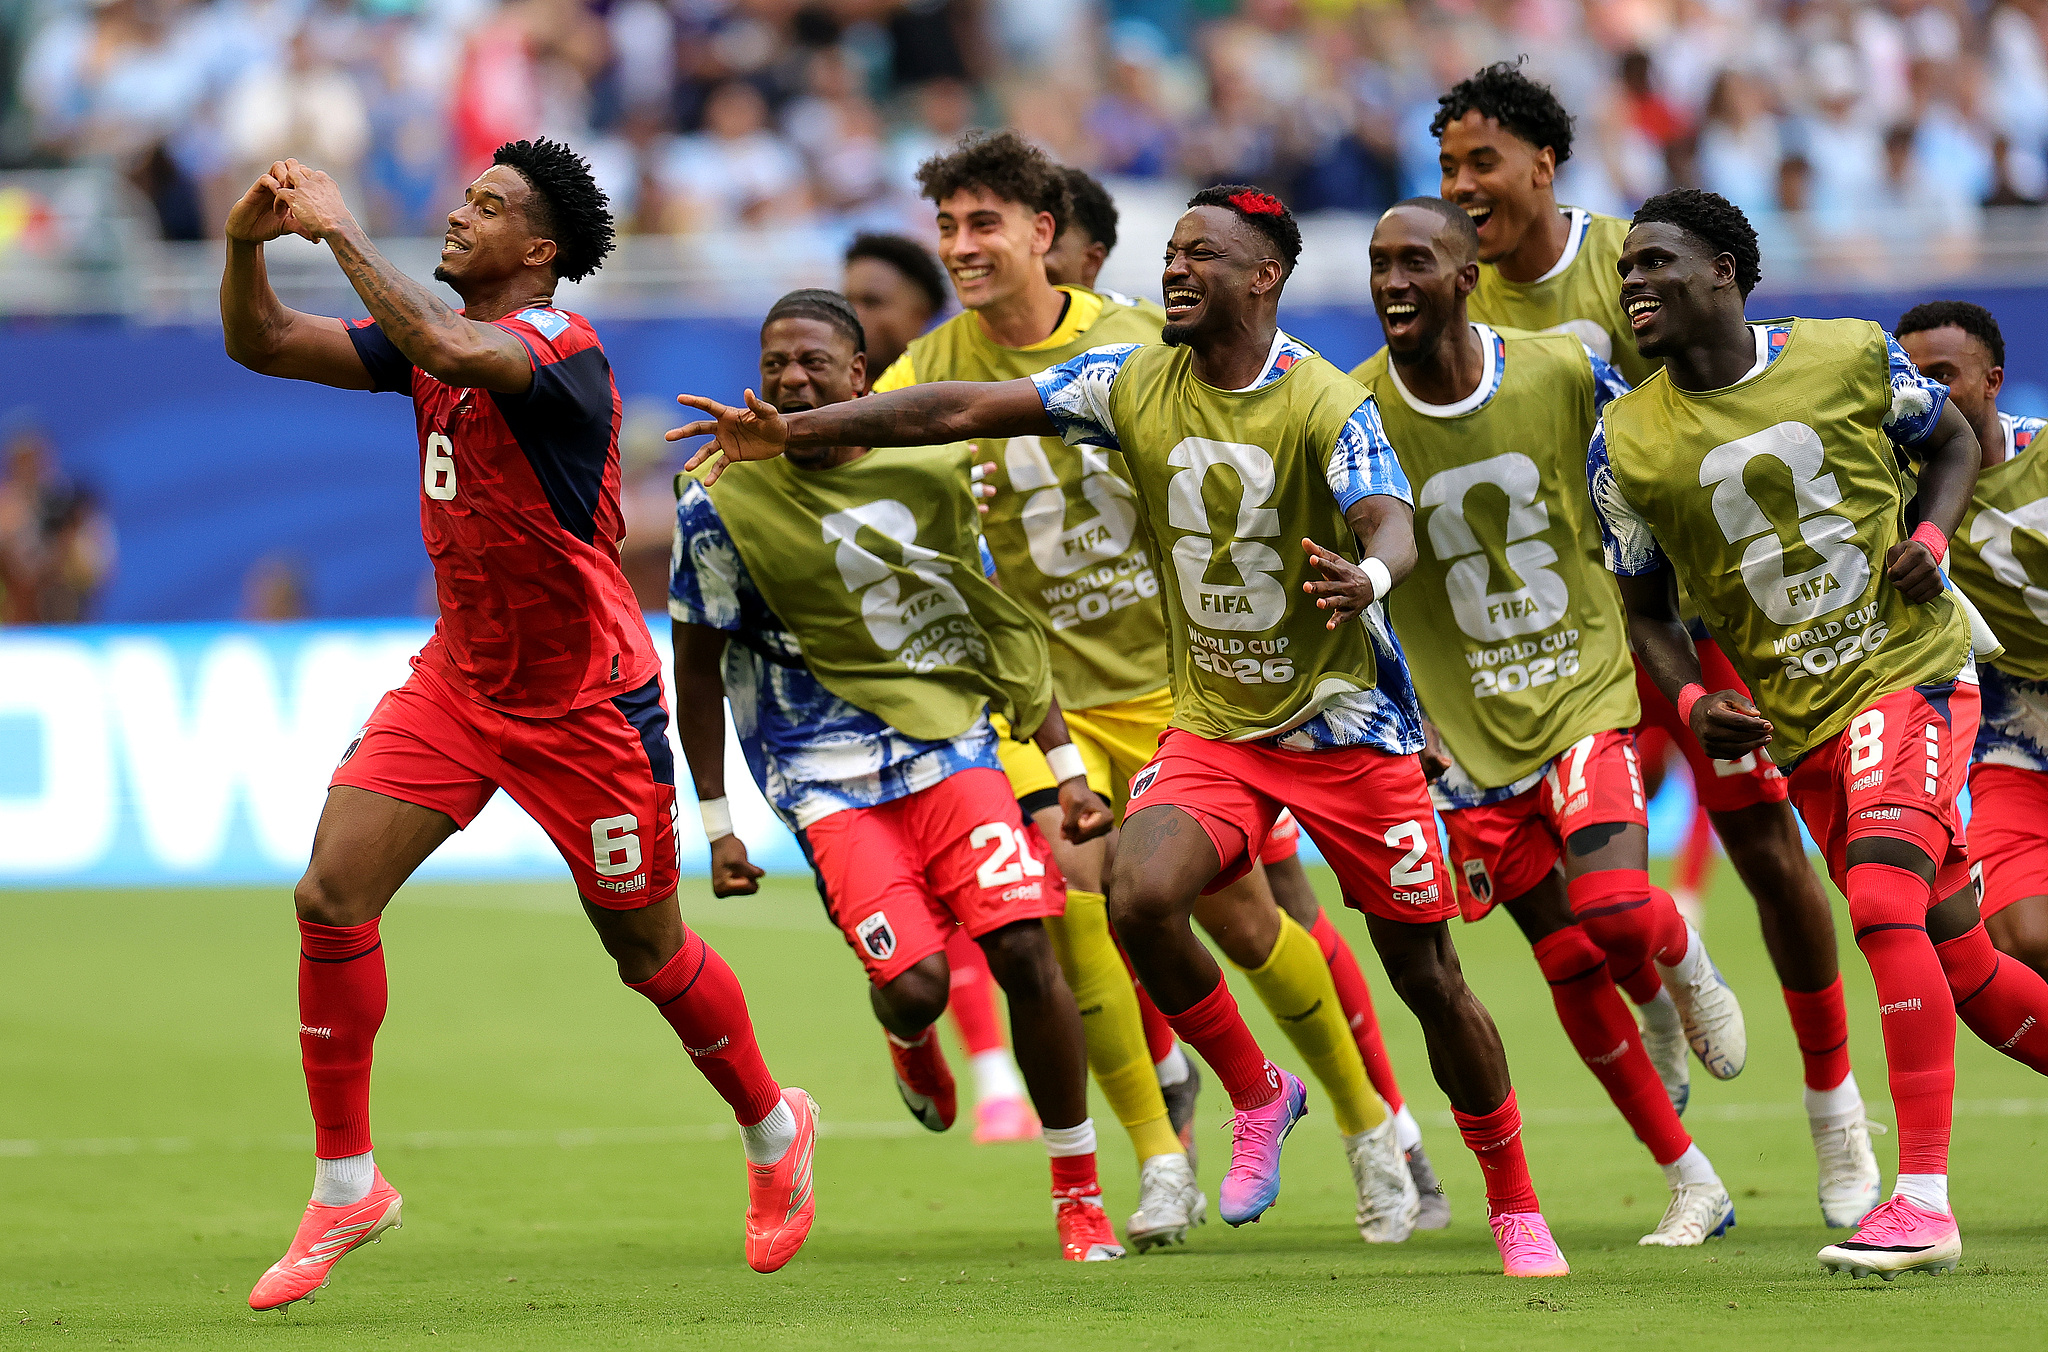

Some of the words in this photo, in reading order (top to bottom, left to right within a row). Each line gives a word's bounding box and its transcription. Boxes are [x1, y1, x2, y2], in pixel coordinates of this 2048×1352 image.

[424, 432, 457, 501] 6
[1062, 525, 1113, 557] FIFA
[1041, 567, 1114, 604] WORLD
[1048, 568, 1160, 632] 2026
[1200, 592, 1254, 614] FIFA
[1785, 572, 1842, 607] FIFA
[1487, 597, 1539, 624] FIFA
[1772, 621, 1842, 656] WORLD
[1844, 600, 1879, 630] CUP
[896, 626, 945, 662] ORLD
[1187, 624, 1246, 656] WORLD
[1248, 636, 1290, 655] CUP
[1465, 641, 1538, 669] WORLD
[1540, 628, 1579, 652] CUP
[1780, 620, 1890, 680] 2026
[1190, 645, 1295, 684] 2026
[1470, 649, 1580, 699] 2026
[1849, 708, 1885, 776] 8
[1546, 734, 1595, 816] 17
[1860, 807, 1902, 820] capelli
[590, 813, 642, 876] 6
[1384, 819, 1434, 887] 2
[596, 872, 646, 893] capelli
[619, 883, 647, 894] SPORT
[1392, 883, 1439, 905] capelli
[1415, 895, 1440, 906] SPORT
